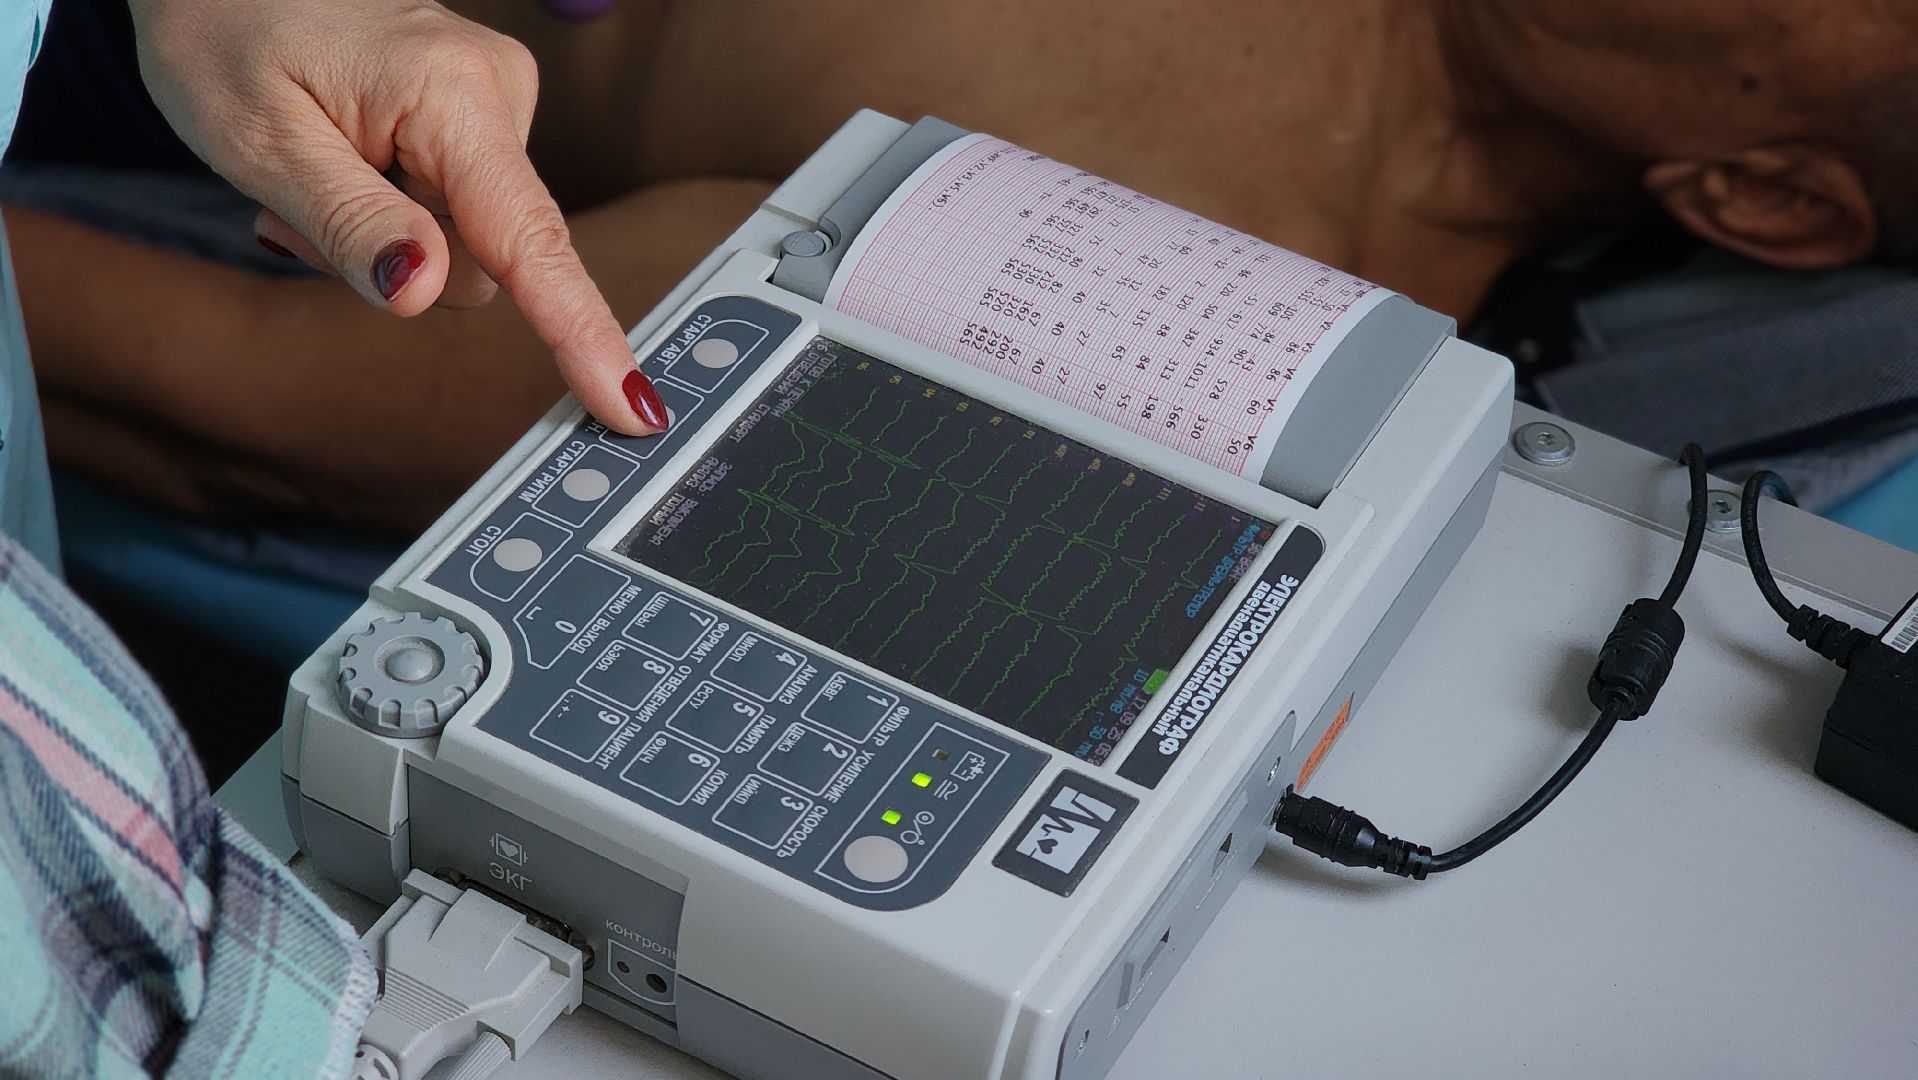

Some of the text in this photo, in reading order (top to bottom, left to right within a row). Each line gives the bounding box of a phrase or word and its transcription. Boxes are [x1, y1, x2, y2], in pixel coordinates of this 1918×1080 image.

[1042, 214, 1059, 228] 565
[1055, 218, 1071, 233] 527
[1067, 223, 1083, 237] 327
[1021, 234, 1039, 249] 565
[1032, 238, 1050, 254] 532
[1044, 243, 1062, 258] 332
[1001, 258, 1019, 275] 565
[1069, 256, 1083, 268] 80
[1012, 262, 1031, 280] 530
[1024, 267, 1043, 284] 330
[1047, 281, 1063, 293] 82
[1220, 282, 1237, 296] 220
[979, 286, 998, 307] 565
[990, 247, 1074, 360] 212 212 162 200
[991, 291, 1010, 312] 520
[1072, 291, 1085, 303] 40
[1176, 294, 1194, 310] 120
[1244, 293, 1257, 306] -53
[1003, 295, 1022, 316] 320
[1096, 300, 1111, 313] 35
[1201, 304, 1218, 319] 504
[1028, 311, 1041, 327] 67
[1226, 310, 1242, 330] -617
[959, 321, 977, 345] 565
[1051, 321, 1064, 336] 40
[1156, 324, 1171, 337] 88
[1261, 329, 1275, 343] -84
[653, 314, 712, 365] СТАРТ АВТ.
[967, 326, 994, 350] 492
[977, 330, 1002, 354] 292
[1076, 330, 1091, 346] 27
[1089, 284, 1169, 400] 182 135 65 97
[1182, 328, 1199, 347] 387
[1205, 334, 1224, 356] -934
[808, 350, 837, 378] ГОТОВ
[1008, 348, 1021, 365] 67
[1135, 355, 1150, 370] 84
[1242, 354, 1256, 371] -43
[1031, 358, 1045, 374] 40
[1160, 358, 1179, 380] 313
[1182, 357, 1207, 388] -1011
[1190, 302, 1285, 439] 609 774 901 528 330
[1266, 368, 1280, 380] 86
[1283, 368, 1297, 380] V4
[1052, 367, 1070, 384] 27
[1115, 393, 1131, 408] 55
[1141, 394, 1158, 419] 198
[1246, 400, 1261, 415] 60
[1263, 399, 1277, 411] V5
[729, 400, 771, 443] СТАНДАРТ
[1227, 438, 1241, 455] 50
[1243, 436, 1257, 451] V6
[518, 441, 586, 503] СТАРТ РИТМ
[465, 526, 502, 556] СТОП
[609, 585, 642, 614] МЕНЮ
[630, 593, 669, 628] ШЩЪЫ
[555, 620, 577, 633] 0
[689, 612, 711, 627] 7
[566, 615, 611, 654] ВЫХОД
[690, 623, 729, 663] ФОРМАТ
[728, 633, 758, 662] МНОП
[595, 644, 626, 671] ЬЭЮЯ
[775, 652, 797, 666] 4
[1152, 581, 1272, 737] двенадцатиканальный
[1158, 574, 1300, 756] ЭЛЕКТРОКАРДИОГРАФ
[643, 660, 666, 674] 8
[779, 664, 818, 704] АНАЛИЗ
[1134, 669, 1149, 683] 10
[635, 665, 692, 723] ОТВЕДЕНИЯ
[822, 674, 846, 701] АБВГ
[690, 685, 714, 709] РСТУ
[866, 695, 889, 707] 1
[598, 711, 620, 725] 9
[733, 702, 756, 717] 5
[735, 714, 776, 753] ПАМЯТЬ
[873, 706, 910, 746] ФИЛЬТР
[1089, 726, 1108, 739] 50
[590, 719, 642, 770] ПАЦИЕНТ
[778, 724, 805, 752] ДЕЖЗ
[635, 734, 666, 763] ФХЦЧ
[823, 742, 848, 758] 2
[688, 753, 711, 767] 6
[823, 750, 875, 803] УСИЛЕНИЕ
[691, 769, 729, 805] КОПИЯ
[781, 796, 805, 810] 3
[777, 806, 828, 857] СКОРОСТЬ
[489, 862, 533, 891] ЭКГ
